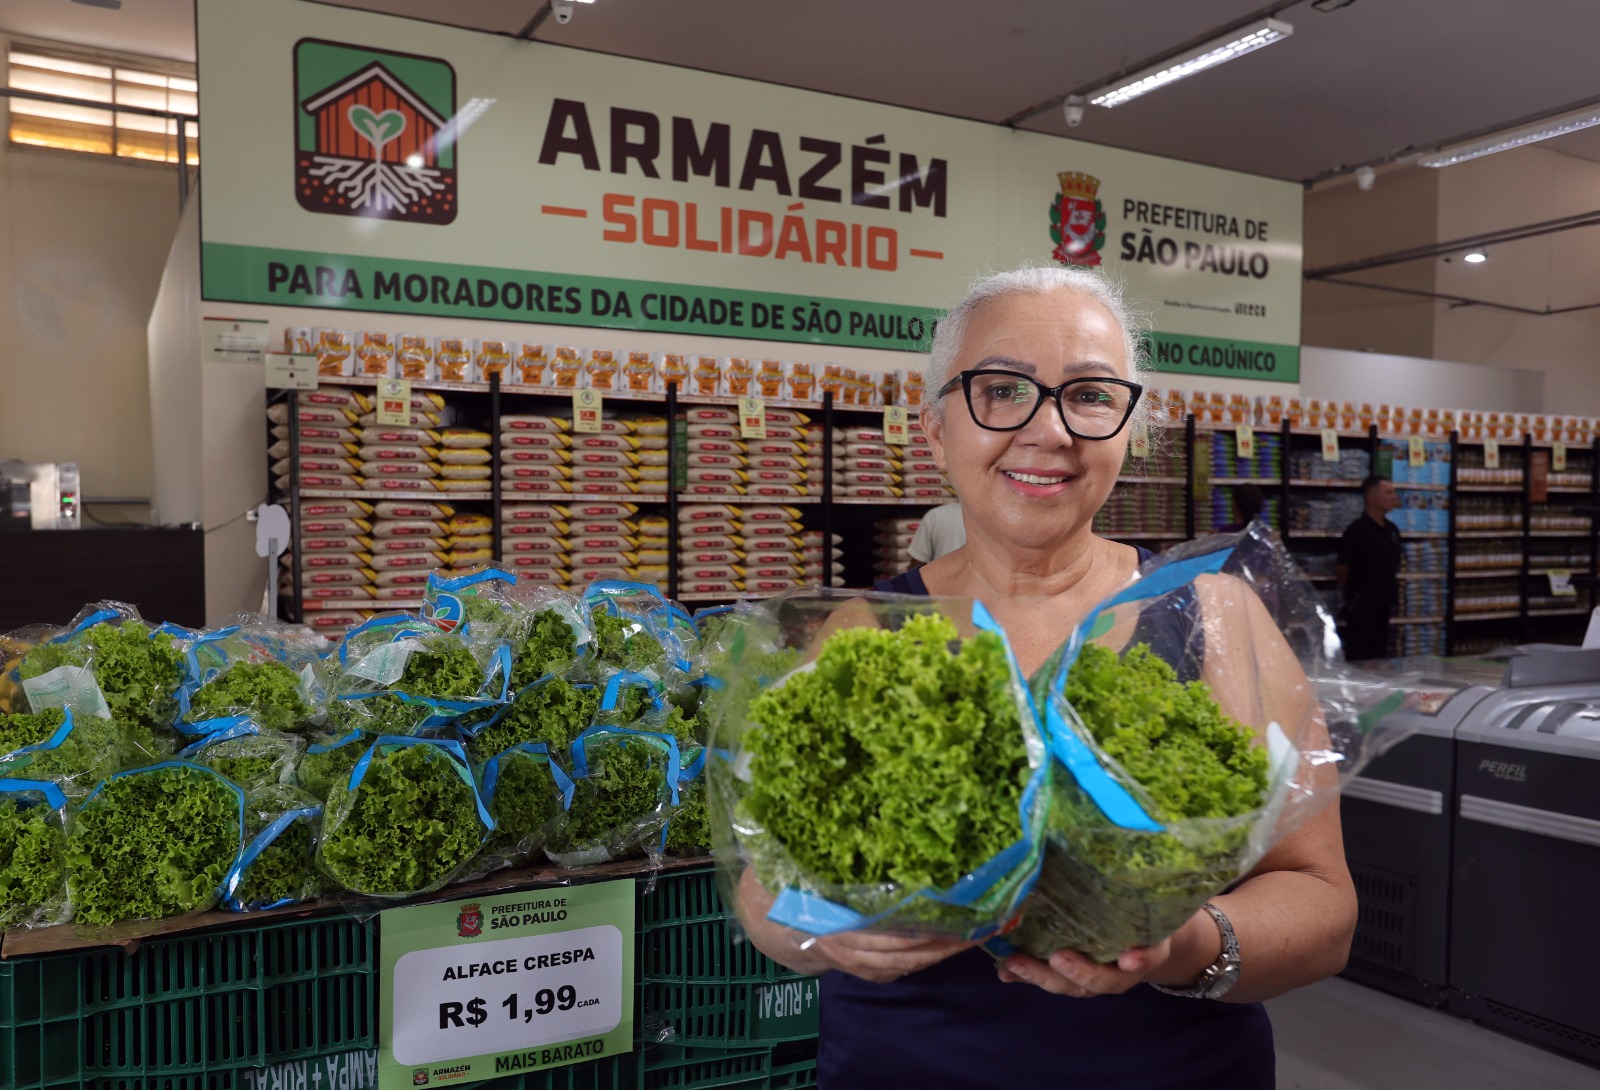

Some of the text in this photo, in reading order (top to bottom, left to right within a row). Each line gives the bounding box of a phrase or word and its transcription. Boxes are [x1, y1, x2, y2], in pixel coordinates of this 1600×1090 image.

[538, 98, 948, 217] ARMAZÉM
[603, 193, 898, 271] SOLIDÁRIO
[1123, 198, 1269, 241] PREFEITURA DE
[1120, 228, 1270, 279] SÃO PAULO
[268, 262, 363, 299] PARA
[374, 271, 581, 315] MORADORES
[591, 288, 632, 319] DA
[641, 293, 744, 328] CIDADE
[751, 303, 785, 332] DE
[792, 299, 843, 335] SÃO
[850, 309, 924, 341] PAULO
[1157, 341, 1184, 364] NO
[1188, 344, 1276, 372] CADÚNICO
[1478, 759, 1527, 778] PERFIL
[490, 910, 568, 930] SÃO PAULO
[491, 898, 567, 915] PREFEITURA DE
[442, 947, 595, 981] ALFACE CRESPA
[439, 985, 600, 1029] R$ 1,99 CADA
[755, 981, 803, 1019] RURAL
[433, 1065, 471, 1076] ARMAZÉM
[495, 1038, 605, 1073] MAIS BARATO
